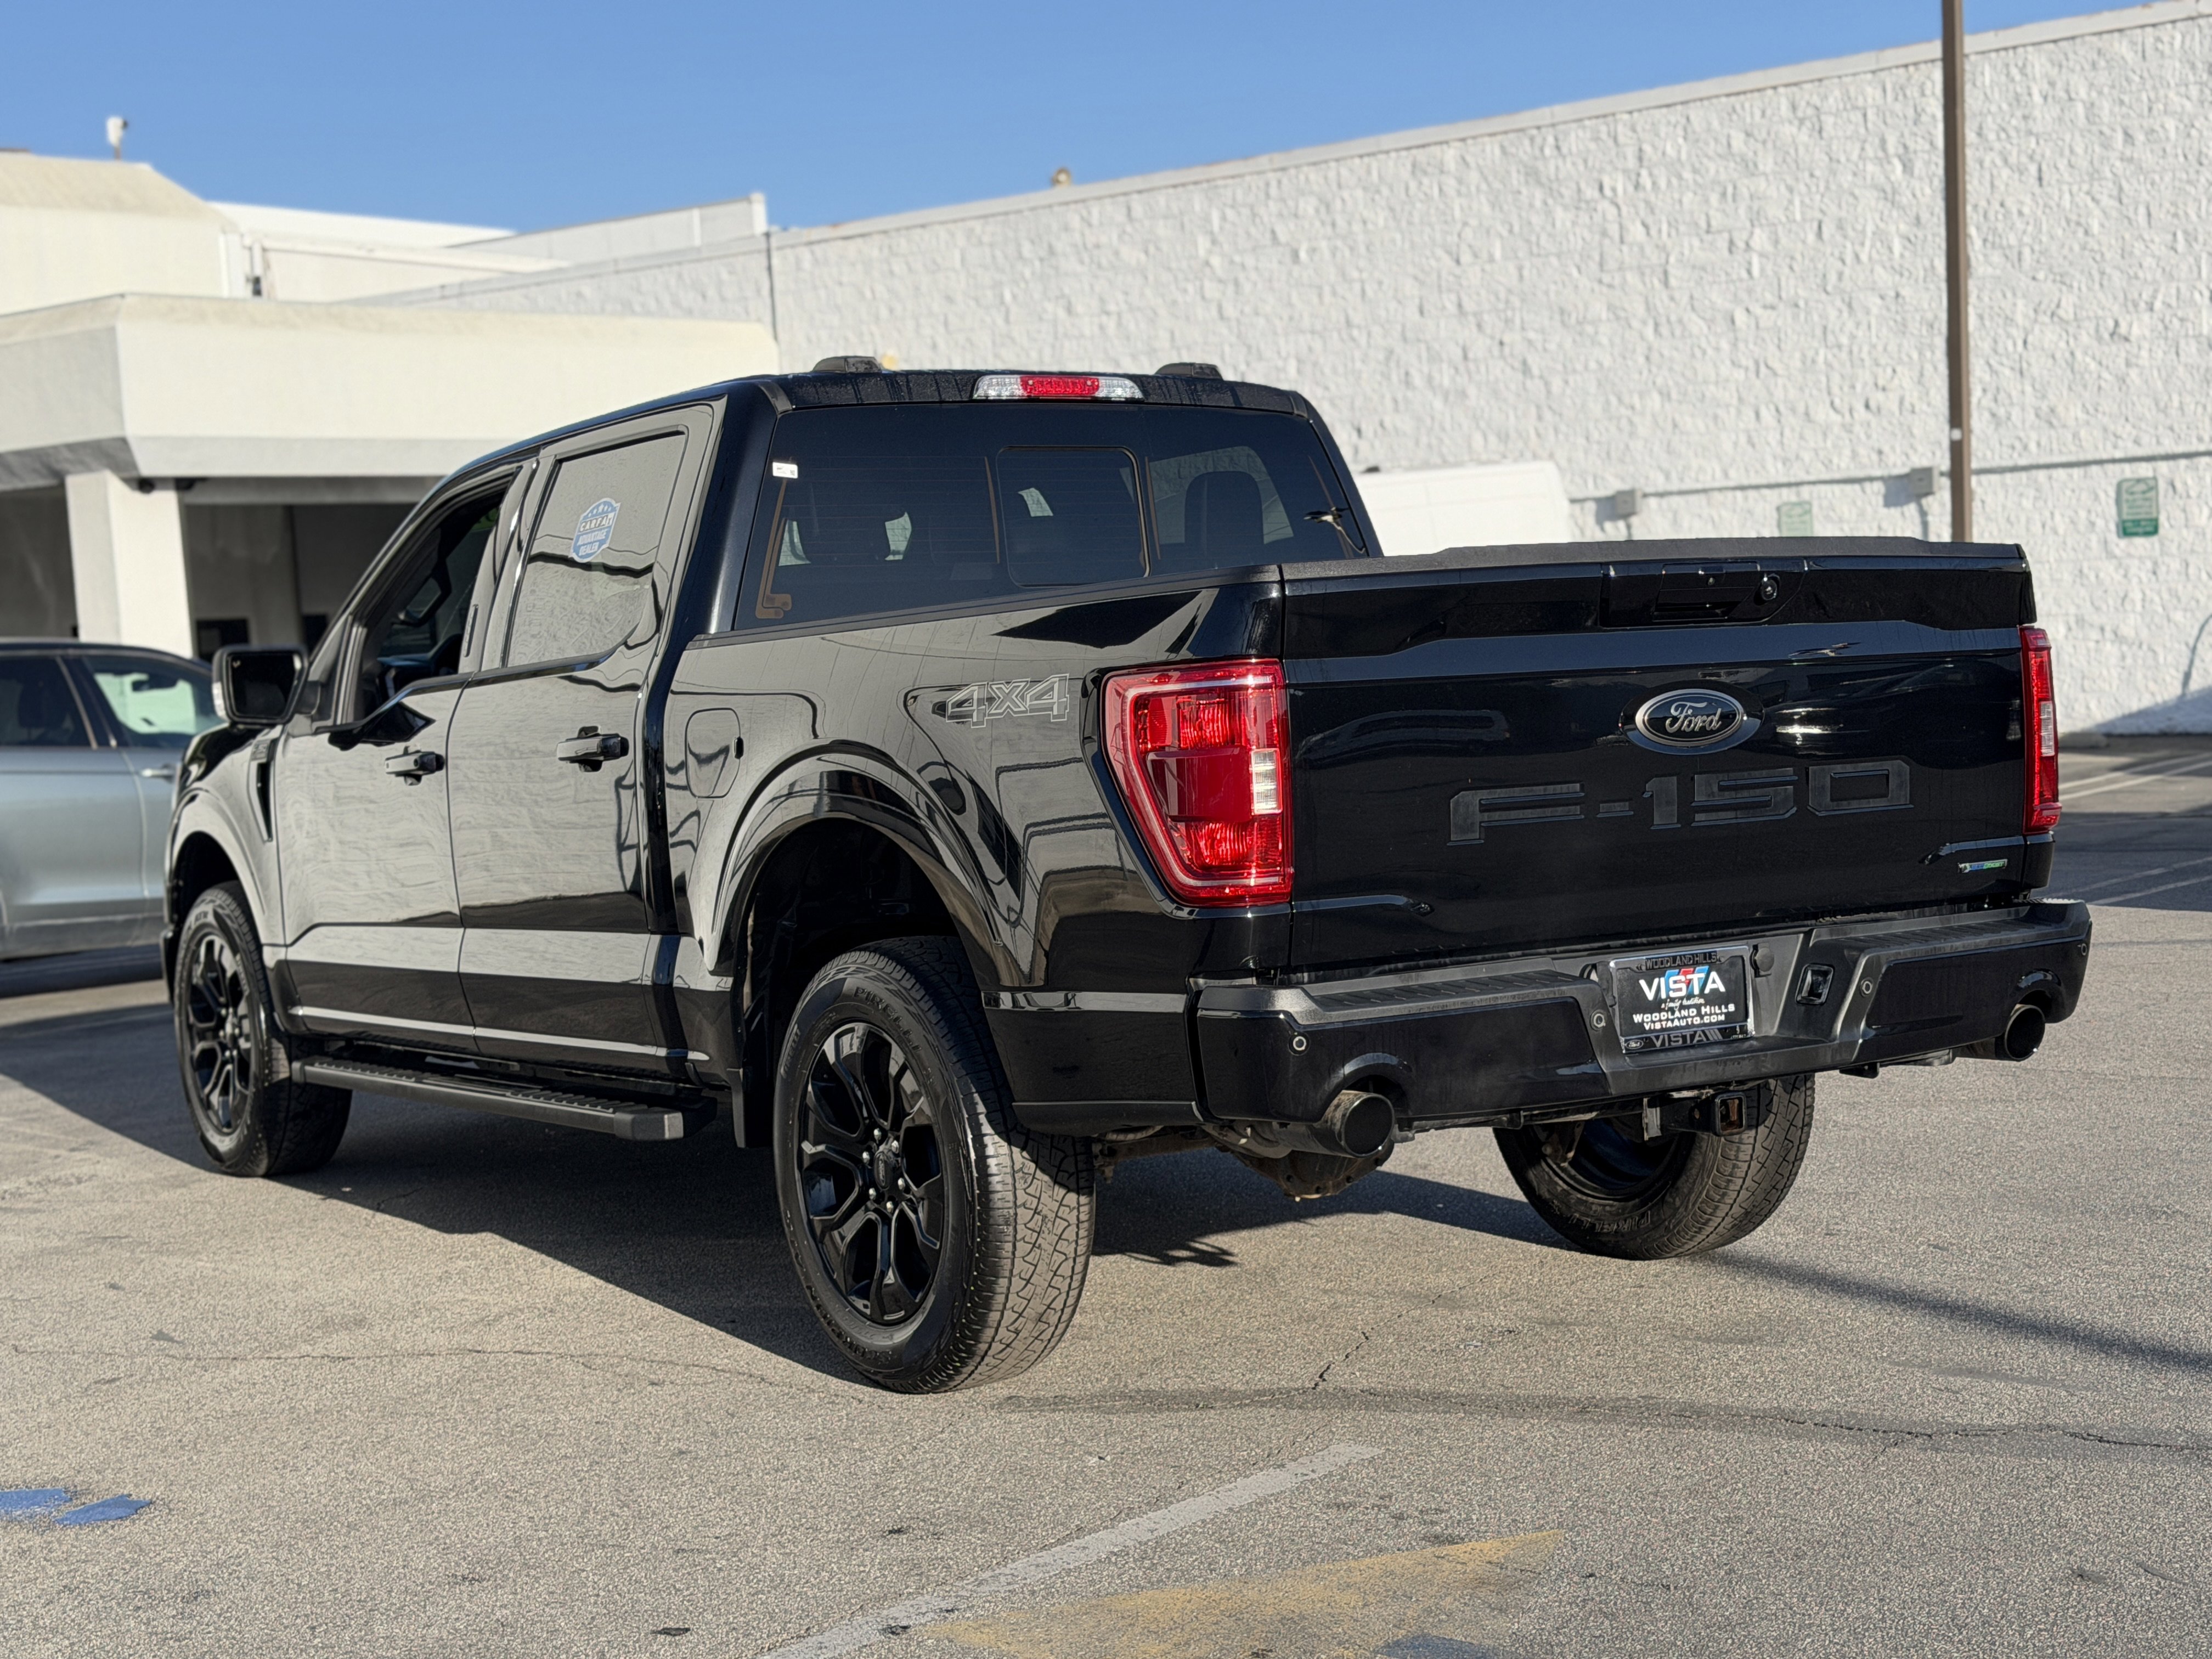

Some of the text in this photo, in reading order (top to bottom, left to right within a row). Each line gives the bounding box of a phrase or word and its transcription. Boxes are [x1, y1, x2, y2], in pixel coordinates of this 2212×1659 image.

[1665, 701, 1722, 733] Ford
[1447, 759, 1914, 846] F-150
[1646, 952, 1717, 970] WOODLAND HILLS
[1639, 971, 1726, 1001] VISTA
[854, 987, 922, 1051] PIRELLI
[1650, 1030, 1707, 1048] VISTA
